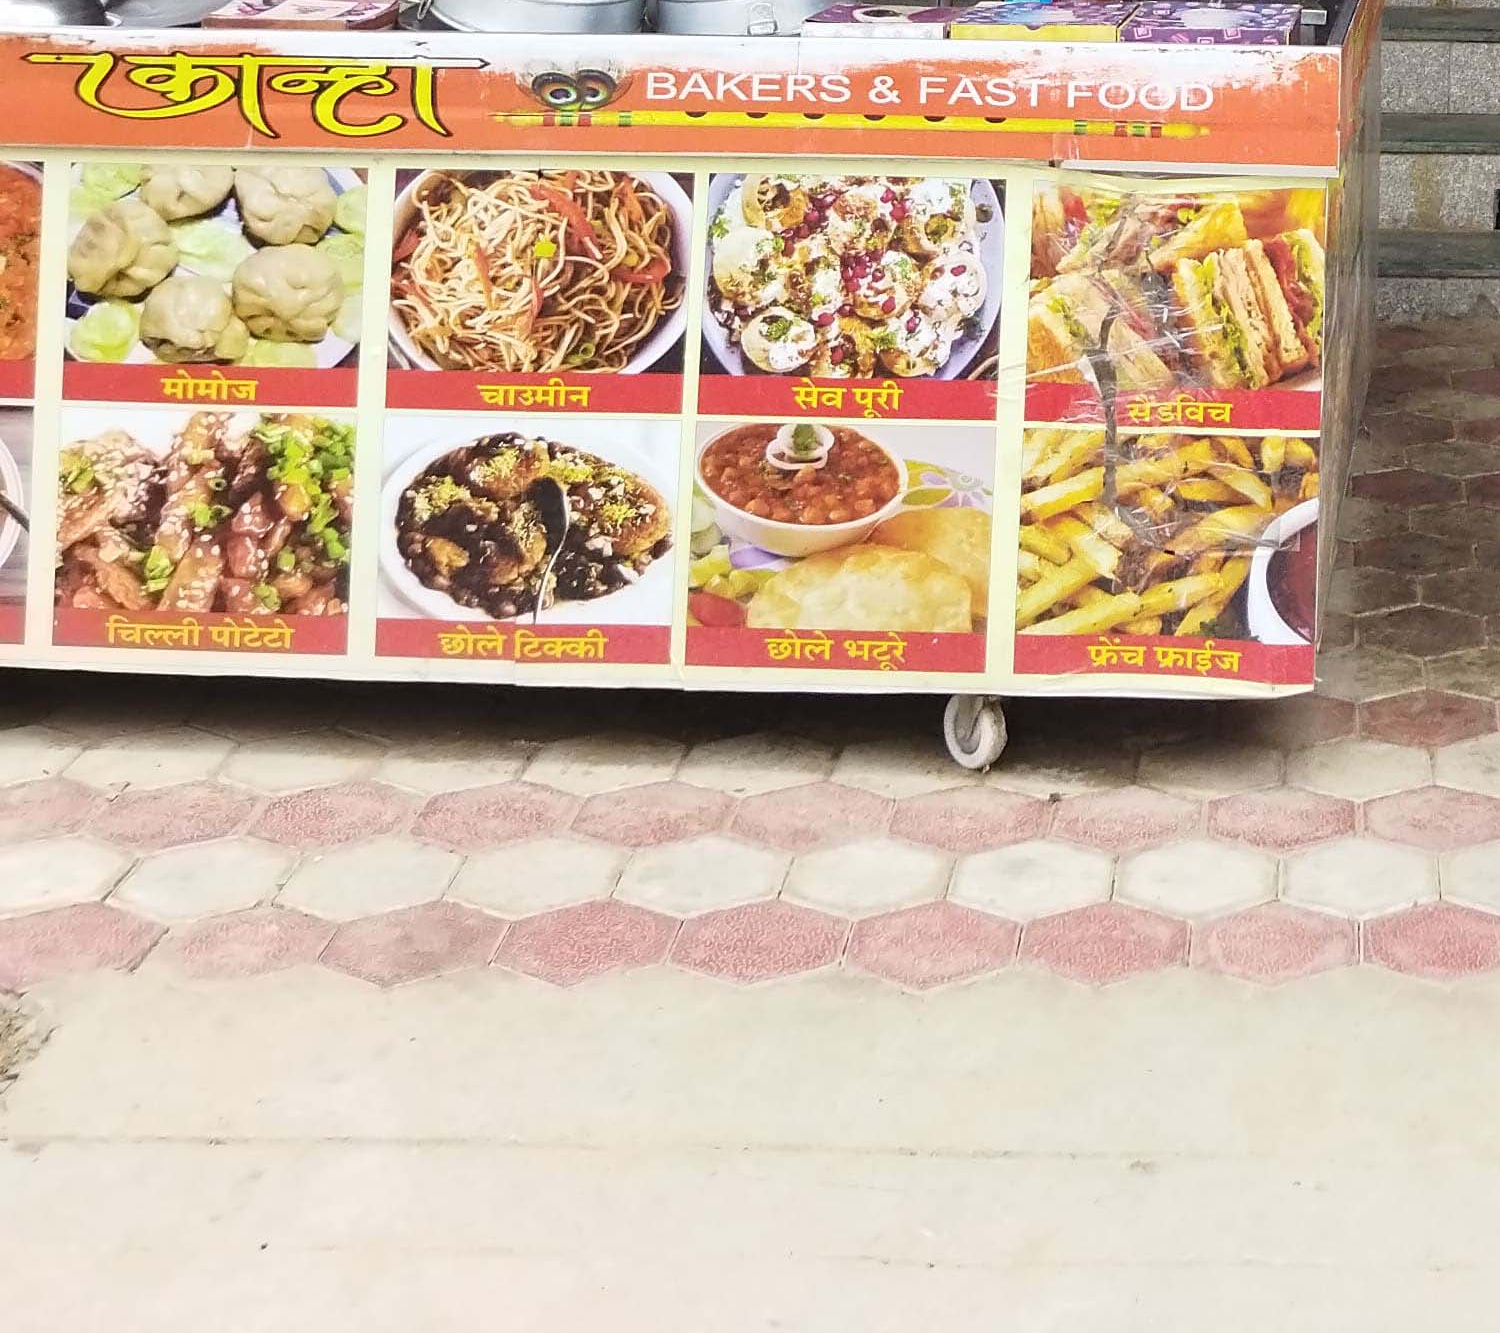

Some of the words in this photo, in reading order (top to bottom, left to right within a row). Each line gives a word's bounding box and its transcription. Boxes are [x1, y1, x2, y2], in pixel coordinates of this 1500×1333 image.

[20, 51, 492, 140] कान्हा
[645, 71, 851, 104] BAKERS
[867, 75, 902, 104] &
[918, 76, 1047, 107] FAST
[1066, 80, 1214, 112] FOOD
[160, 369, 259, 402] मोमोज
[476, 377, 592, 407] चाउमीन
[791, 377, 848, 410] सेव
[851, 380, 905, 419] पूरी
[105, 614, 204, 646] चिल्ली
[208, 617, 296, 649] पोटेटो
[437, 624, 508, 657] छोले
[513, 628, 609, 659] टिक्की
[764, 628, 835, 661] छोले
[843, 631, 908, 671] भटूरे
[1087, 636, 1147, 668] फ्रेंच
[1152, 639, 1243, 677] फ्राईज
